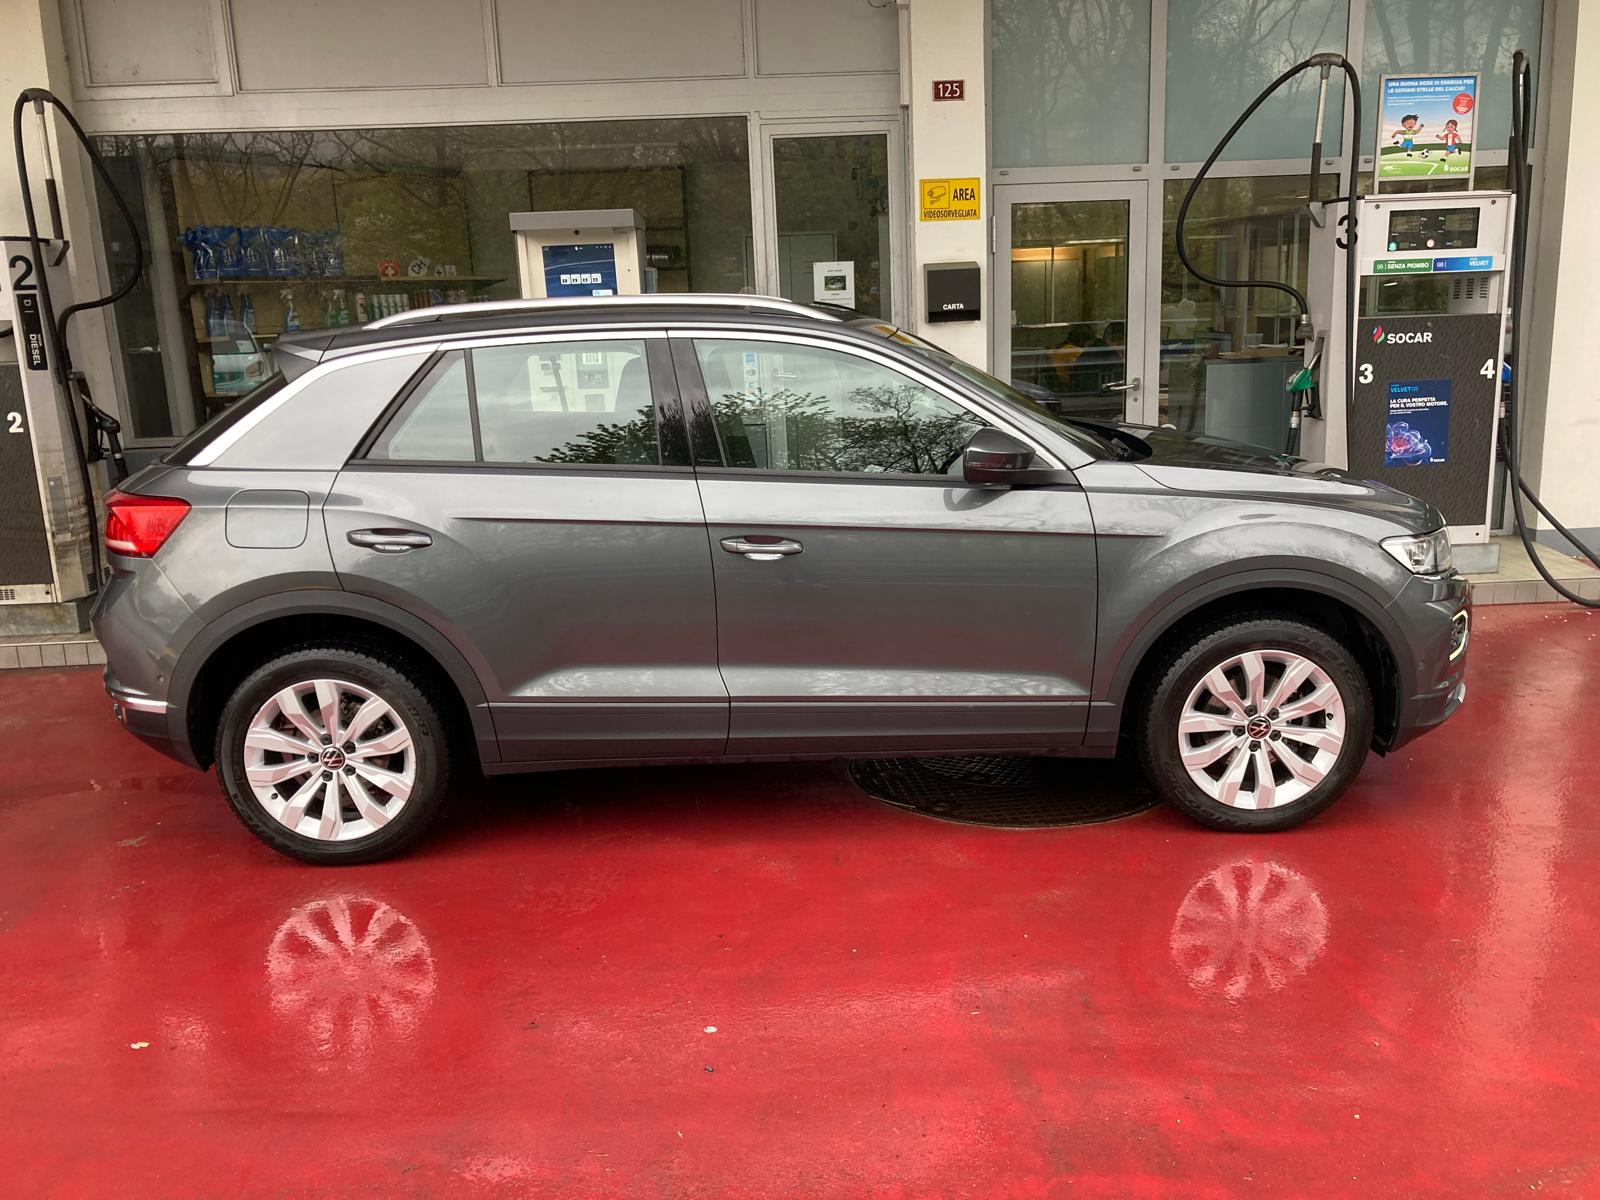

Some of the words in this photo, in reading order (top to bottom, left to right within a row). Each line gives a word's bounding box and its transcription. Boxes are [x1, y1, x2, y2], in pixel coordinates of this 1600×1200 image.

[938, 83, 960, 97] 125
[953, 188, 976, 201] AREA
[923, 209, 977, 219] VIDEOSORVEGLIATA
[1336, 214, 1358, 250] 3
[9, 255, 37, 291] 2
[411, 260, 426, 275] CH
[942, 302, 964, 311] CARTA
[1386, 332, 1433, 344] SOCAR
[29, 333, 41, 366] DIESEL
[1358, 363, 1374, 384] 3
[1479, 358, 1496, 379] 4
[7, 411, 24, 433] 2
